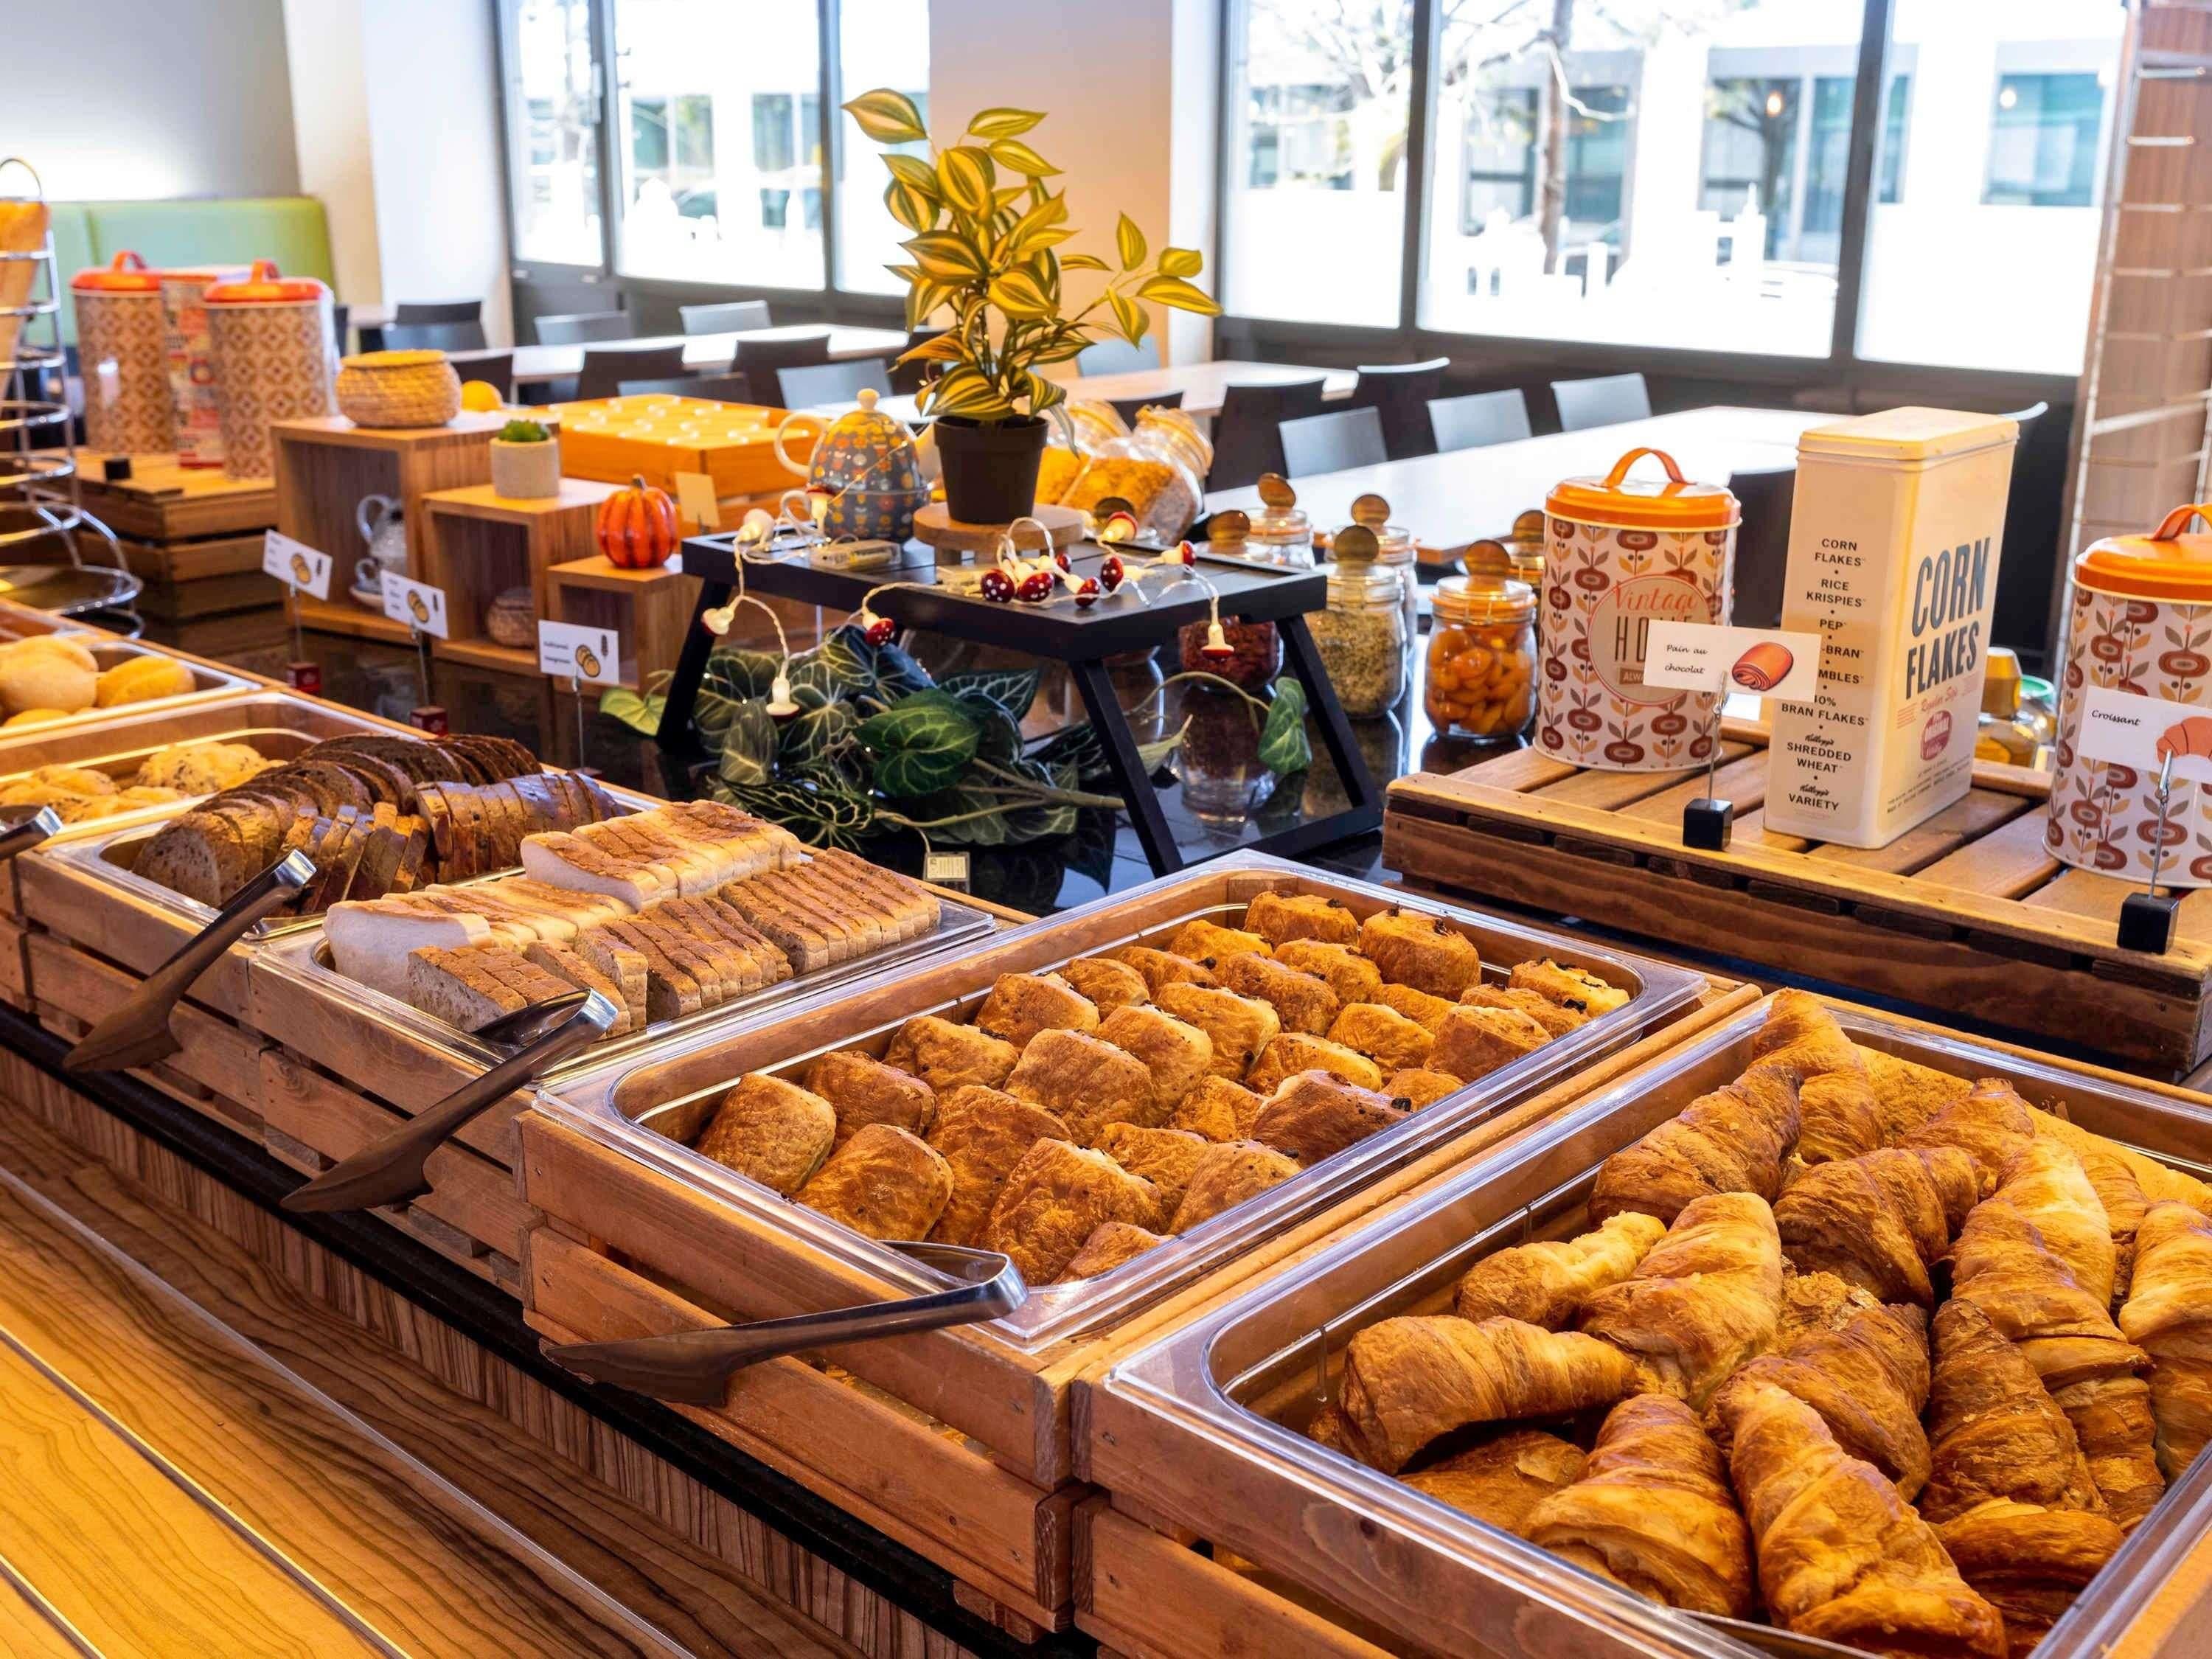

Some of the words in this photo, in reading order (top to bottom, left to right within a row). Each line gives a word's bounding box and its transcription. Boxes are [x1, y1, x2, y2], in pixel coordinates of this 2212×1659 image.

[1821, 538, 1857, 552] CORN
[1815, 552, 1863, 567] FLAKES
[1820, 578, 1850, 591] RICE
[1911, 537, 1991, 638] CORN
[1614, 580, 1696, 622] Vintage
[1806, 591, 1863, 608] KRISPIES
[1819, 619, 1844, 630] PEP
[1613, 615, 1693, 662] HO
[1666, 644, 1690, 655] Pain
[1905, 620, 1980, 700] FLAKES
[1664, 663, 1705, 675] chocolat
[1818, 669, 1860, 685] MBLES
[1781, 703, 1814, 717] BRAN
[1818, 710, 1865, 726] FLAKES
[2091, 709, 2141, 726] Croissant
[1787, 742, 1852, 762] SHREDDED
[1797, 757, 1839, 773] WHEAT
[1788, 793, 1840, 811] VARIETY
